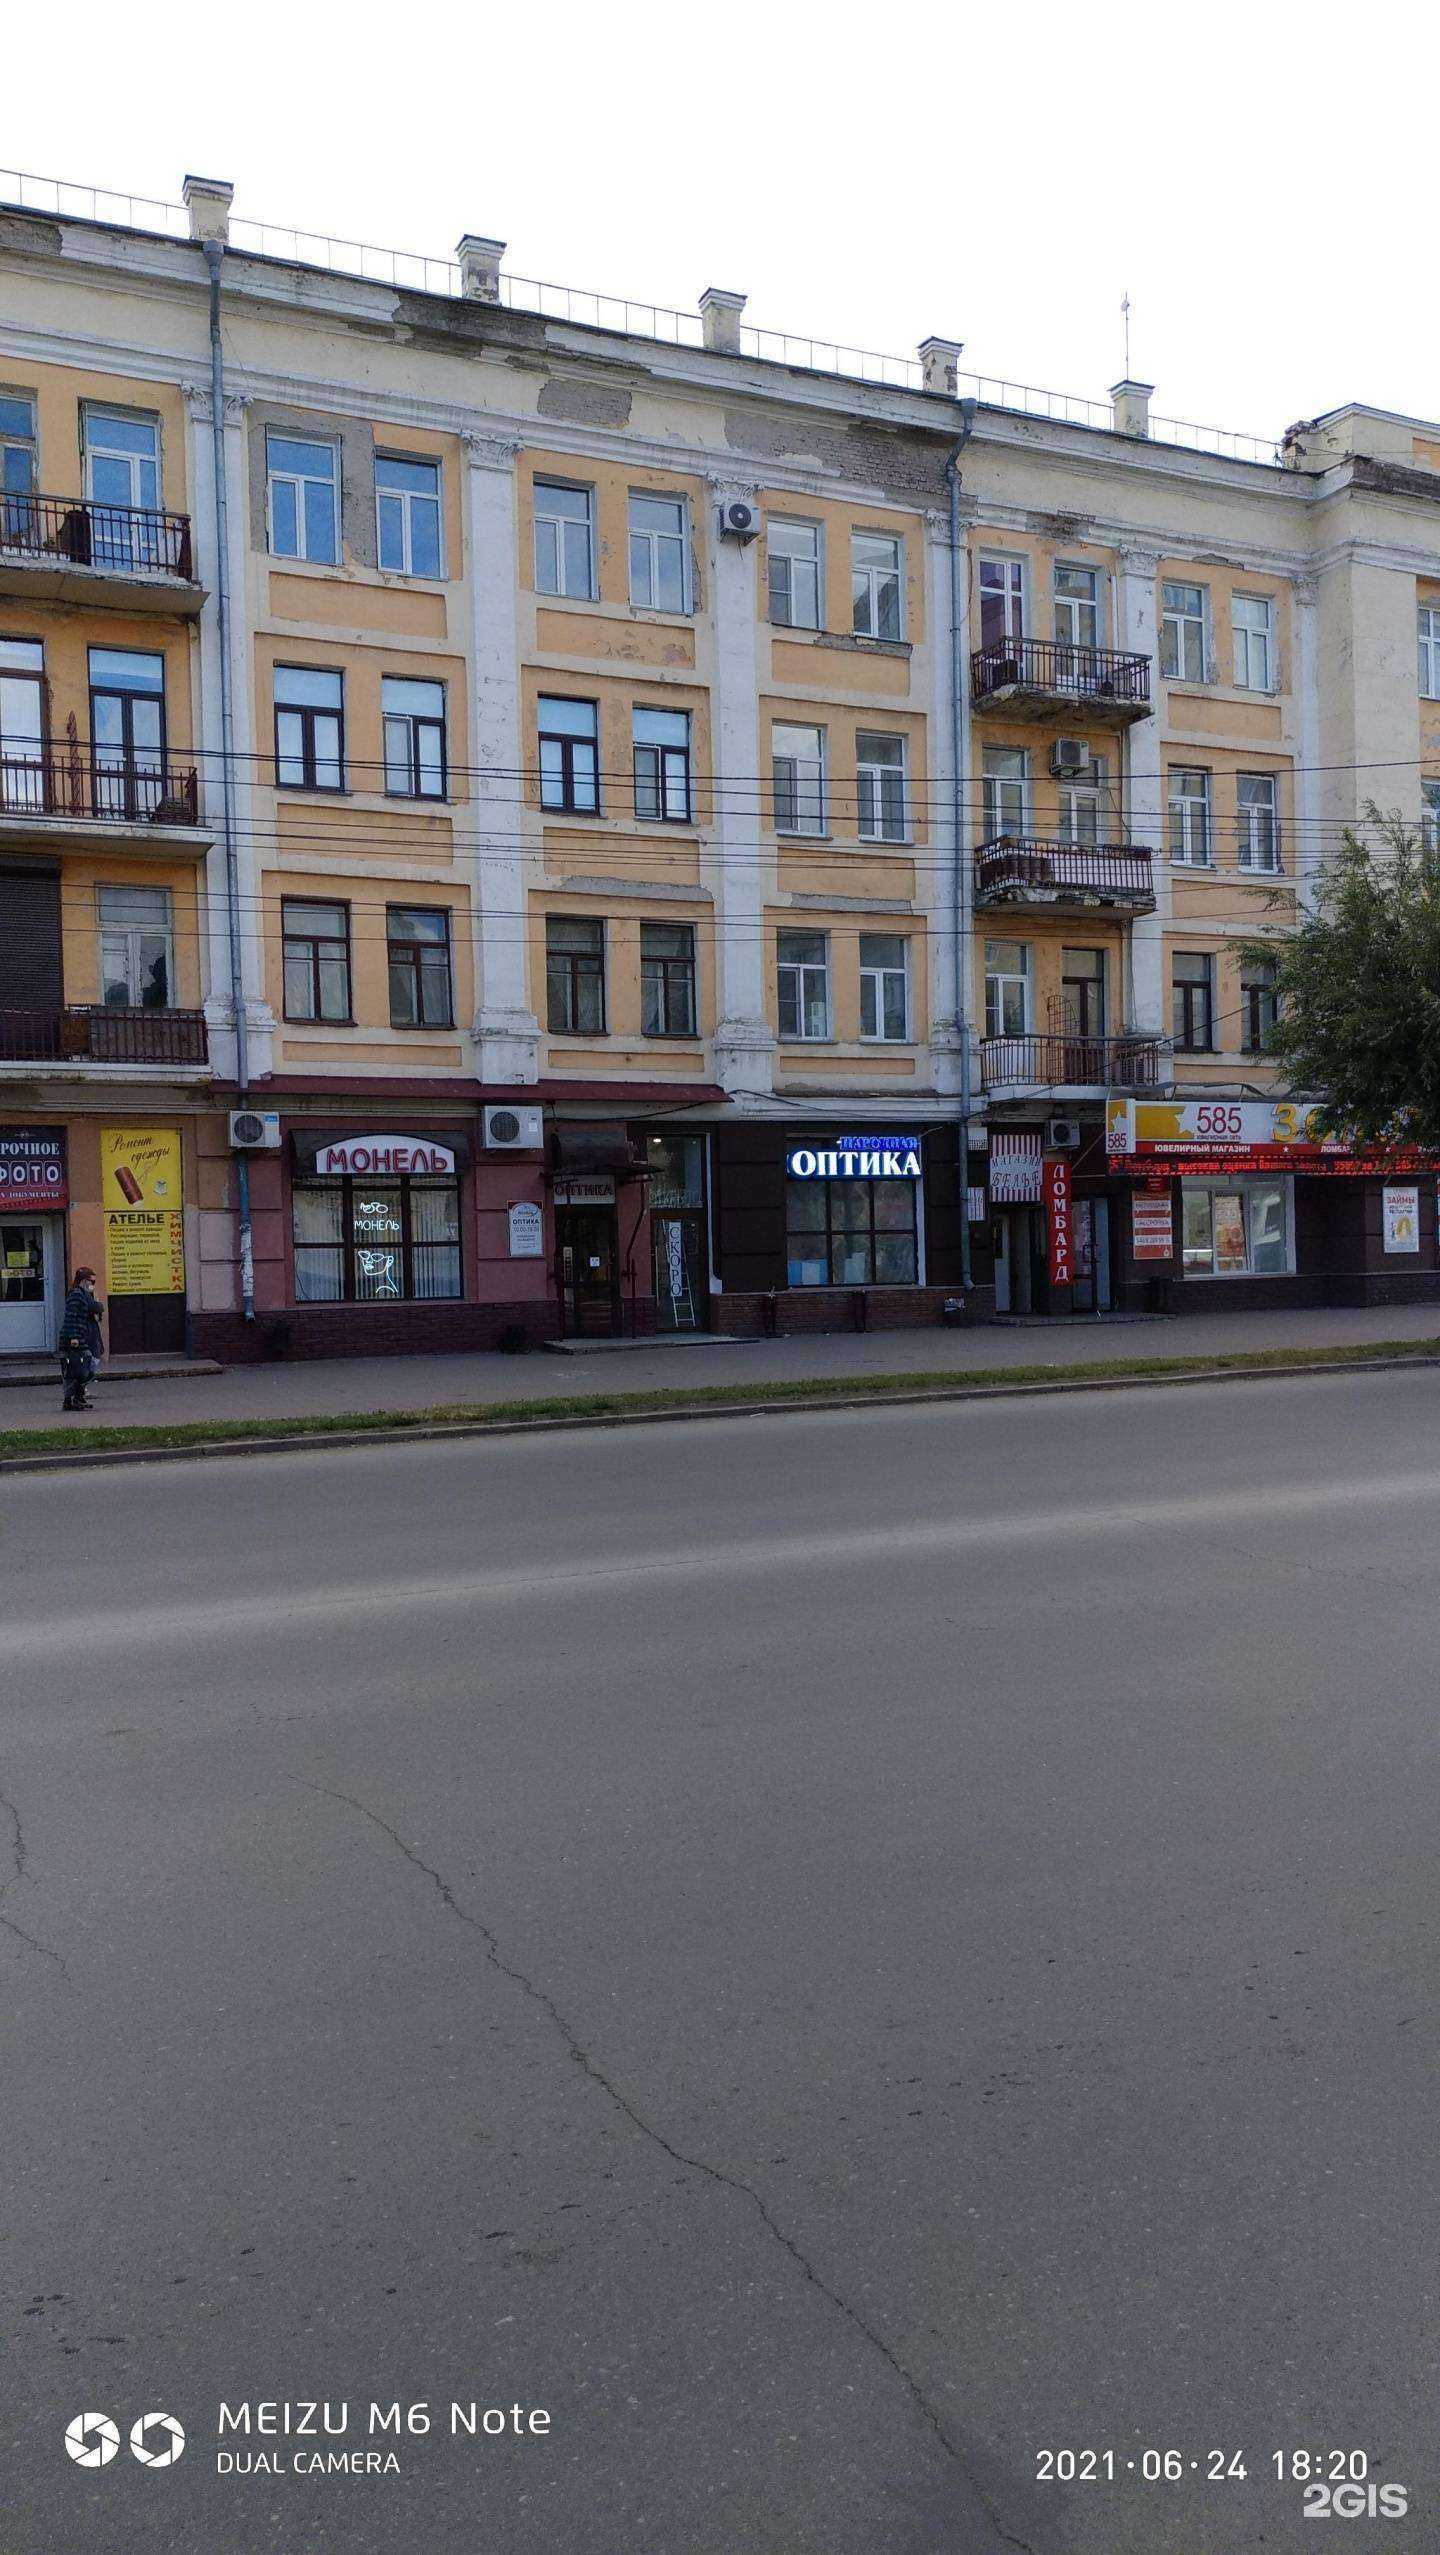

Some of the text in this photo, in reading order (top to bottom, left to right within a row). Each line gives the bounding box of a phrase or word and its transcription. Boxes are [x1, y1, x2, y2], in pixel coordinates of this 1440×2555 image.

[1197, 1106, 1242, 1134] 585
[839, 1136, 918, 1150] НАРОДНАЯ
[1107, 1133, 1127, 1149] 585
[1154, 1143, 1251, 1153] ЮВЕЛИРНЫЙ МАГАЗИН
[326, 1148, 448, 1173] МОНЕЛЬ
[791, 1150, 922, 1176] ОПТИКА
[991, 1169, 1042, 1190] БЕЛЬЕ
[109, 1213, 165, 1225] АТЕЛЬЕ
[353, 1219, 400, 1231] МОНЕЛЬ
[1053, 1164, 1069, 1281] ЛОМБАРД
[169, 1212, 183, 1291] ХИМЧИСТКА
[669, 1226, 682, 1296] СКОРО
